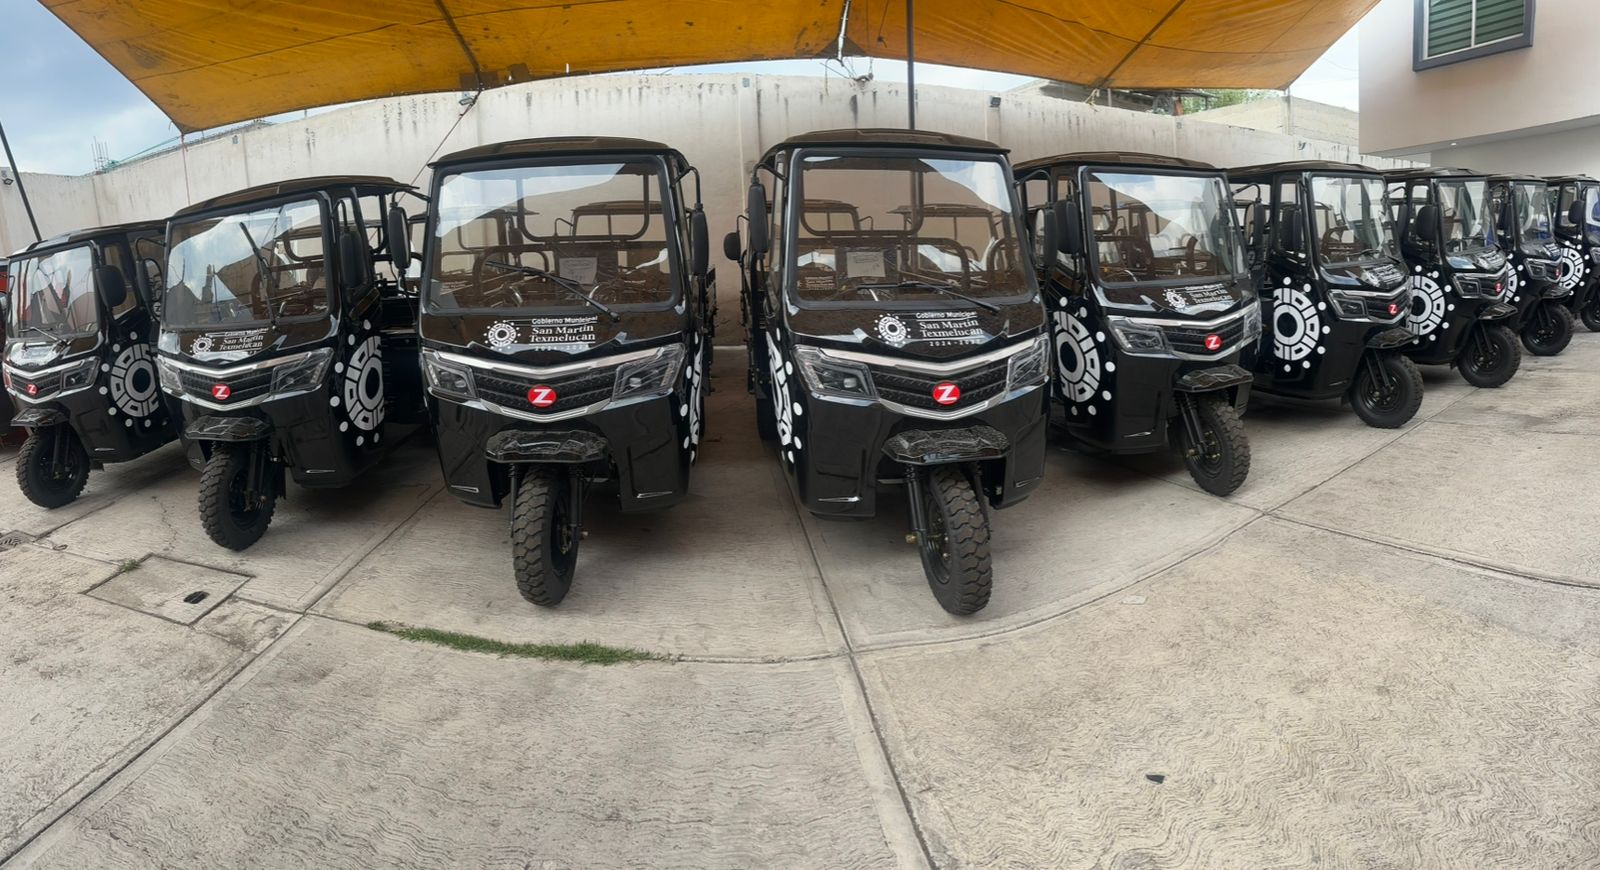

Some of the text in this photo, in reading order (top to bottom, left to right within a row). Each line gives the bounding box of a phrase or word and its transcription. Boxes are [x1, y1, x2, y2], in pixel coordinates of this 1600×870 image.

[564, 316, 598, 324] Municipal
[532, 326, 553, 335] San
[919, 321, 940, 330] San
[528, 333, 596, 343] Texmelucan
[920, 328, 984, 338] Texmelucan
[1207, 336, 1220, 349] Z
[28, 384, 36, 394] Z
[215, 385, 228, 398] Z
[937, 384, 957, 402] Z
[531, 388, 553, 404] Z
